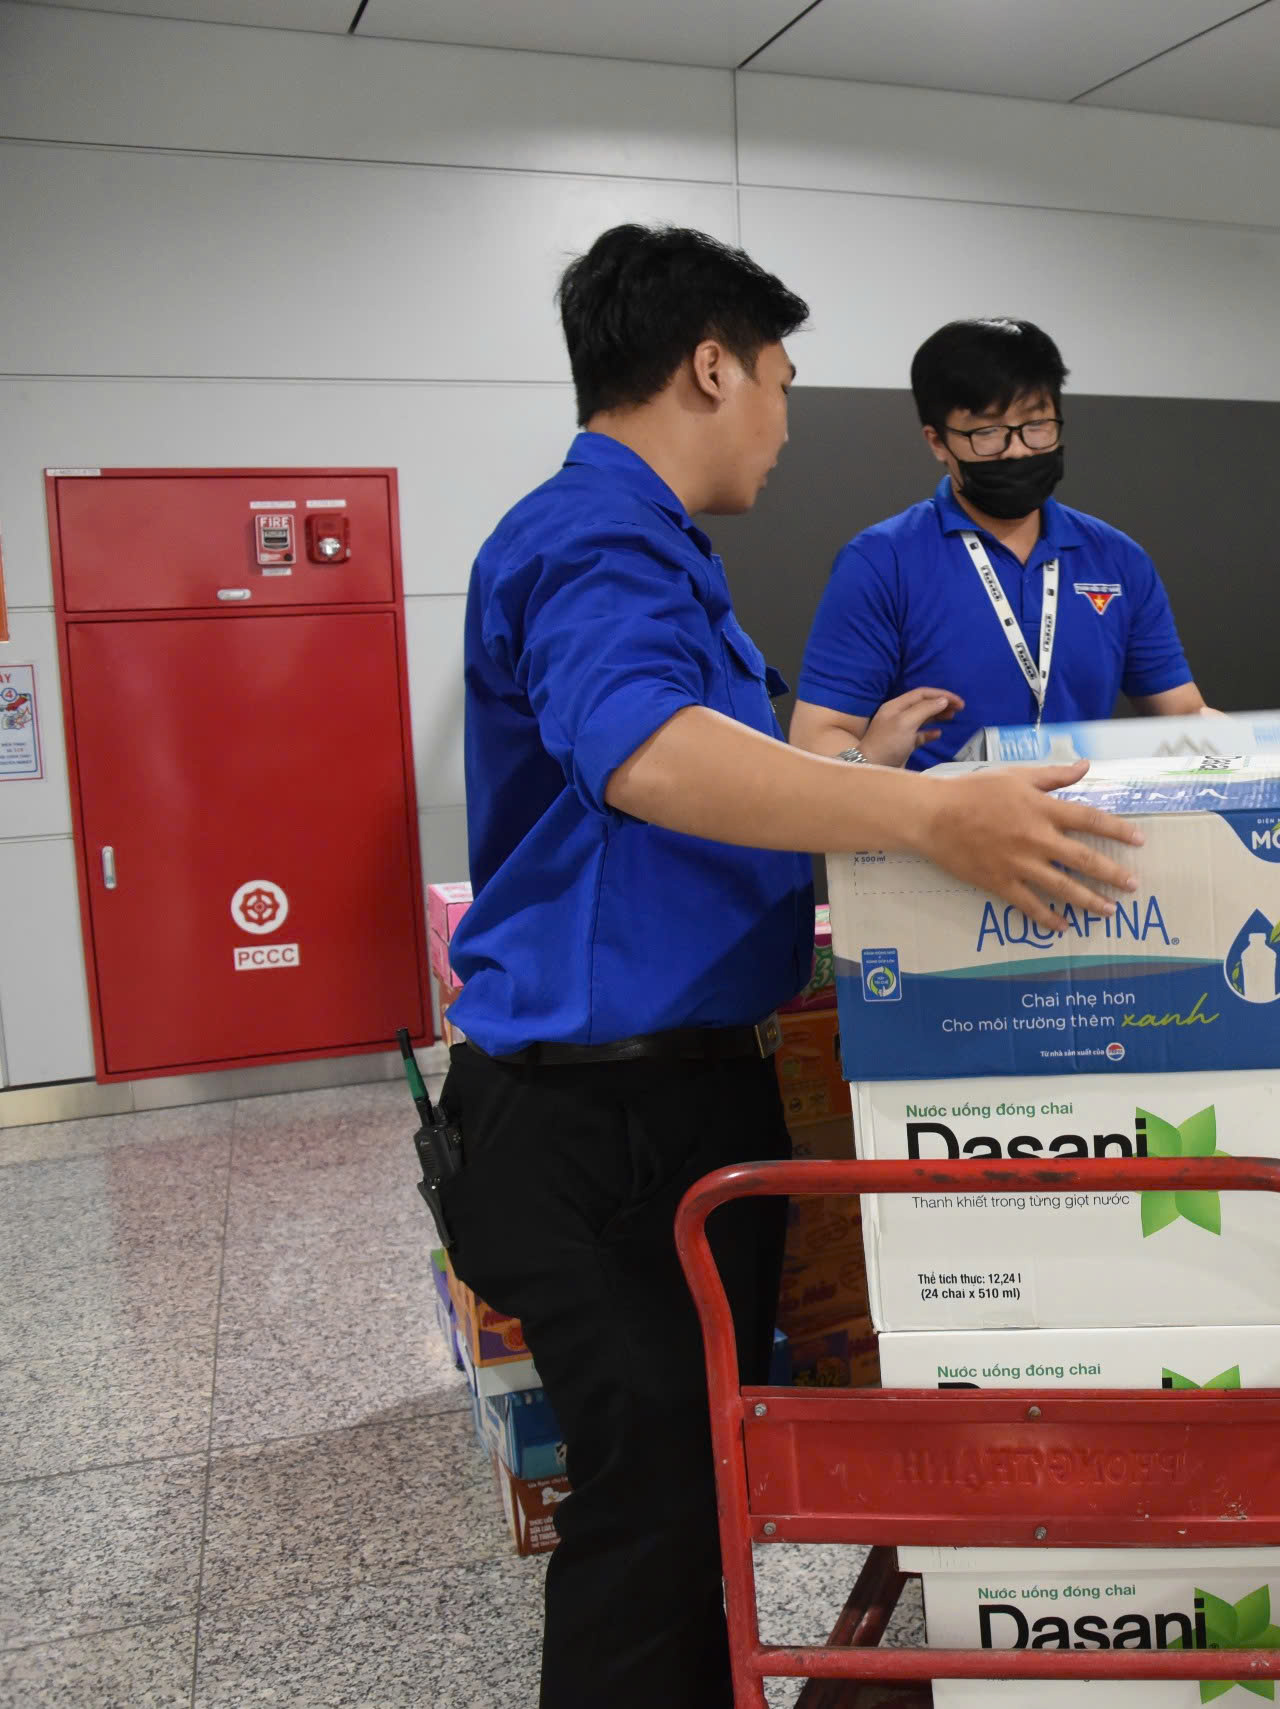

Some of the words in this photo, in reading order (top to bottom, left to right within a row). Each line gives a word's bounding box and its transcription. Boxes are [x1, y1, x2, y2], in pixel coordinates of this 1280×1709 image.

[260, 516, 290, 528] FIRE
[977, 896, 1170, 952] AQUAFINA
[238, 947, 295, 967] PCCC
[1021, 993, 1059, 1008] Chai
[1065, 992, 1097, 1008] nhẹ
[1103, 990, 1136, 1005] hơn
[942, 1018, 973, 1032] Cho
[978, 1016, 1008, 1031] môi
[1013, 1013, 1066, 1032] trường
[1071, 1012, 1115, 1028] thêm
[1122, 992, 1220, 1028] xanh
[1050, 1049, 1063, 1057] nhà
[906, 1104, 947, 1118] Nước
[952, 1103, 991, 1119] uống
[995, 1103, 1036, 1118] đóng
[1040, 1102, 1073, 1116] chai
[906, 1117, 1148, 1160] Dasani
[911, 1196, 953, 1209] Thanh
[956, 1193, 986, 1208] khiết
[990, 1195, 1026, 1210] trong
[1029, 1194, 1061, 1210] từng
[1064, 1194, 1090, 1210] giọt
[1093, 1192, 1130, 1206] nước
[918, 1270, 936, 1284] Thể
[939, 1272, 958, 1284] tích
[960, 1273, 986, 1287] thực:
[988, 1272, 1016, 1286] 12,24
[921, 1288, 939, 1301] (24
[941, 1288, 966, 1299] chai
[968, 1290, 976, 1299] x
[978, 1287, 999, 1299] 510
[1002, 1287, 1021, 1301] ml)
[937, 1365, 978, 1378] Nước
[982, 1363, 1021, 1379] uống
[1025, 1364, 1064, 1379] đóng
[1068, 1363, 1101, 1376] chai
[977, 1586, 1017, 1599] Nước
[1021, 1585, 1059, 1600] uống
[1062, 1585, 1101, 1600] đóng
[1105, 1583, 1136, 1596] chai
[978, 1598, 1208, 1650] Dasani
